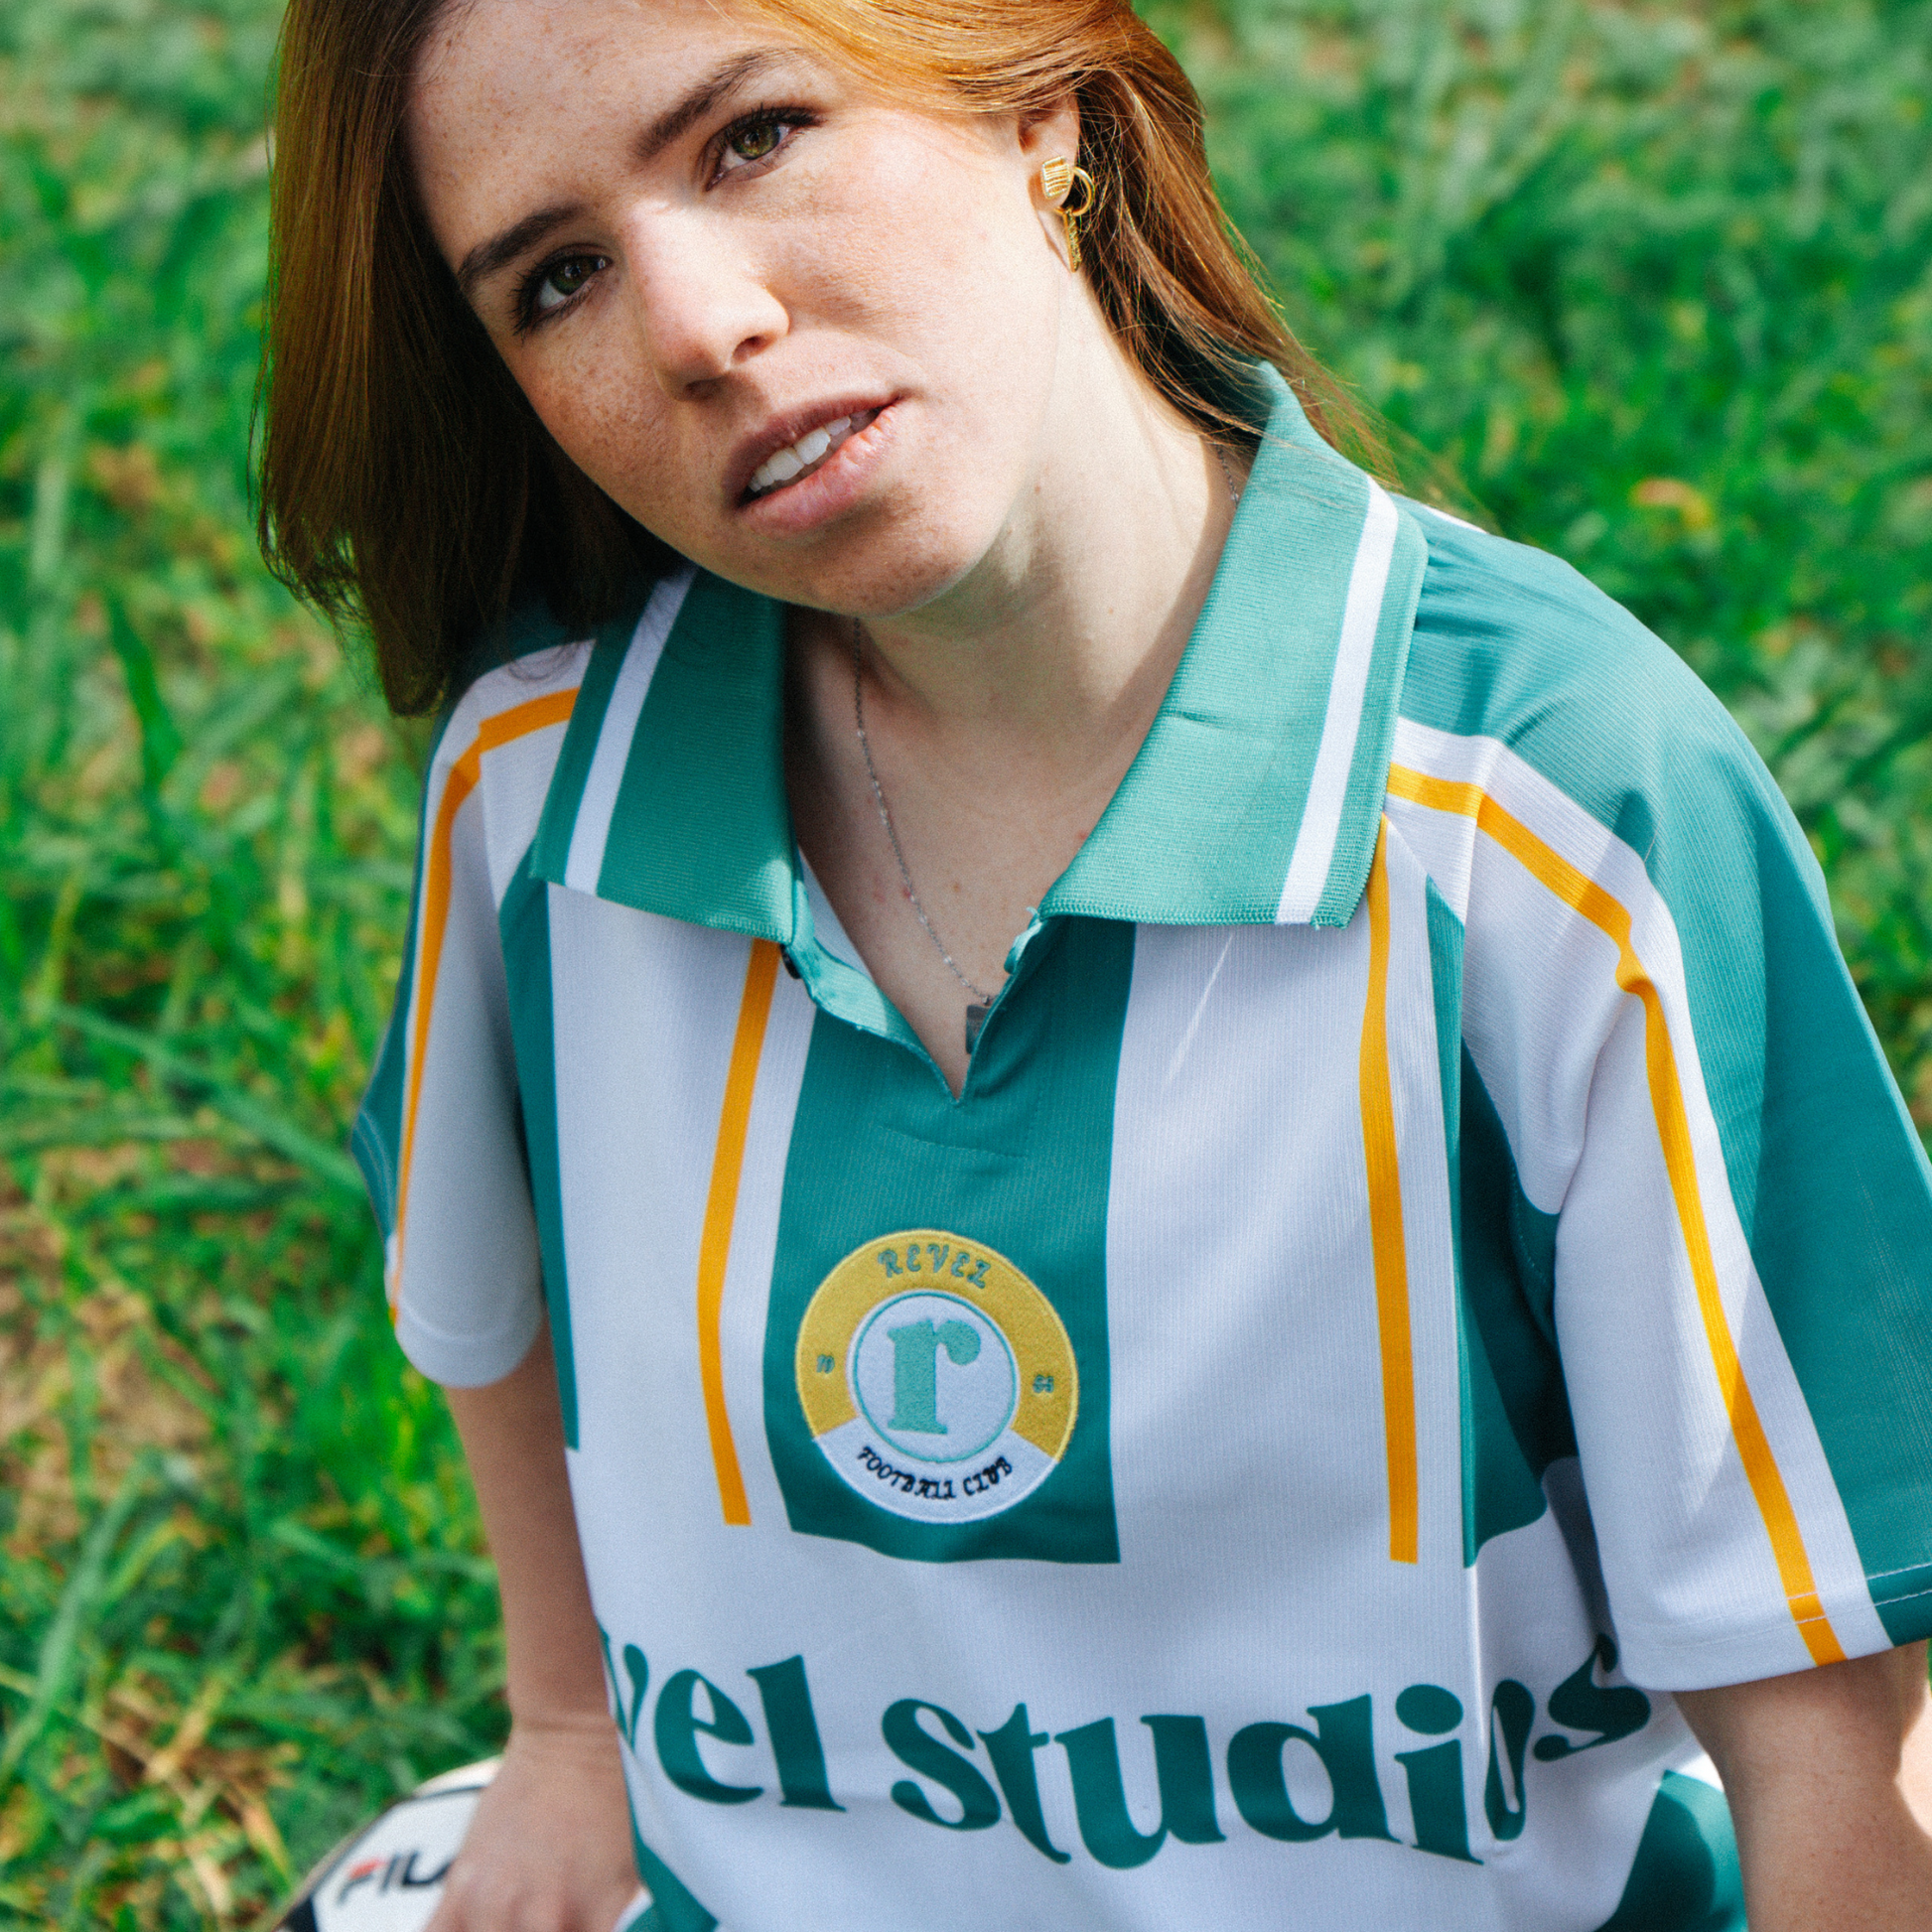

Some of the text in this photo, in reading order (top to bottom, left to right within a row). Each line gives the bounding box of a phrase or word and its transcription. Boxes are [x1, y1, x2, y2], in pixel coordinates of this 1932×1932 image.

[878, 1244, 991, 1289] REVEZ
[857, 1446, 1013, 1500] FOOTBALL CLUB
[881, 1633, 1651, 1869] studios
